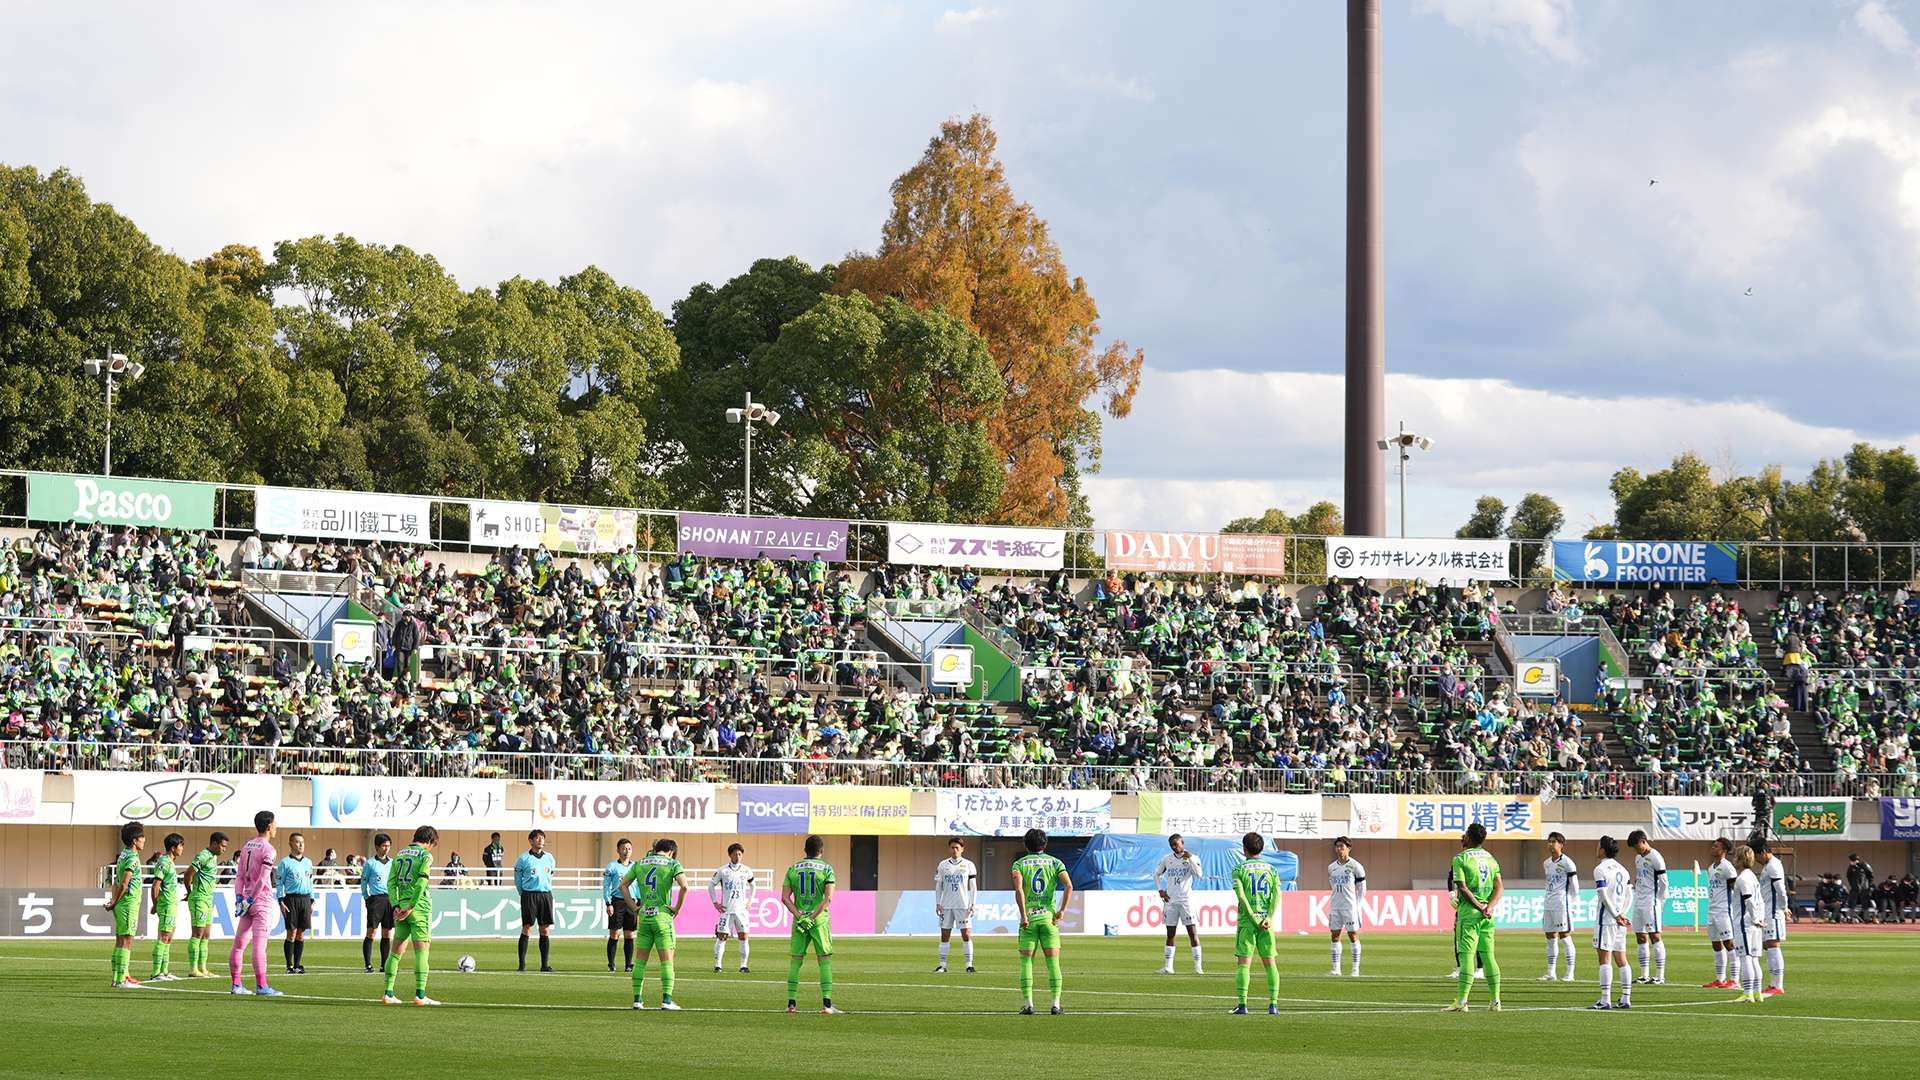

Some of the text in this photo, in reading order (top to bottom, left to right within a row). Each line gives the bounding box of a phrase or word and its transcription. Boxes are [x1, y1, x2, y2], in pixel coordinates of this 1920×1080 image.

[73, 479, 171, 521] Pasco
[320, 509, 419, 537] 品川鐵工場
[504, 515, 547, 533] SHOEI
[680, 526, 825, 547] SHONAN TRAVEL
[1112, 532, 1221, 561] DAIYU
[1358, 550, 1504, 569] チガサキレンタル株式会社
[1616, 543, 1706, 564] DRONE
[1616, 565, 1706, 582] FRONTIER
[404, 790, 500, 817] タチバナ
[557, 795, 710, 820] TK COMPANY
[740, 801, 809, 818] TOKKEI
[999, 815, 1097, 829] 馬車道法律事務所
[1166, 811, 1319, 835] 株式会社 蓮沼工業
[1683, 811, 1756, 826] フリーデ
[396, 857, 414, 882] 22
[644, 865, 658, 892] 4
[1031, 866, 1046, 895] 6
[1478, 859, 1489, 883] 9
[731, 890, 740, 899] 23
[797, 870, 817, 897] 11
[951, 883, 959, 892] 15
[1247, 871, 1269, 898] 14
[1615, 871, 1625, 896] 8
[1001, 904, 1019, 920] 22
[1308, 895, 1439, 927] KNAMI
